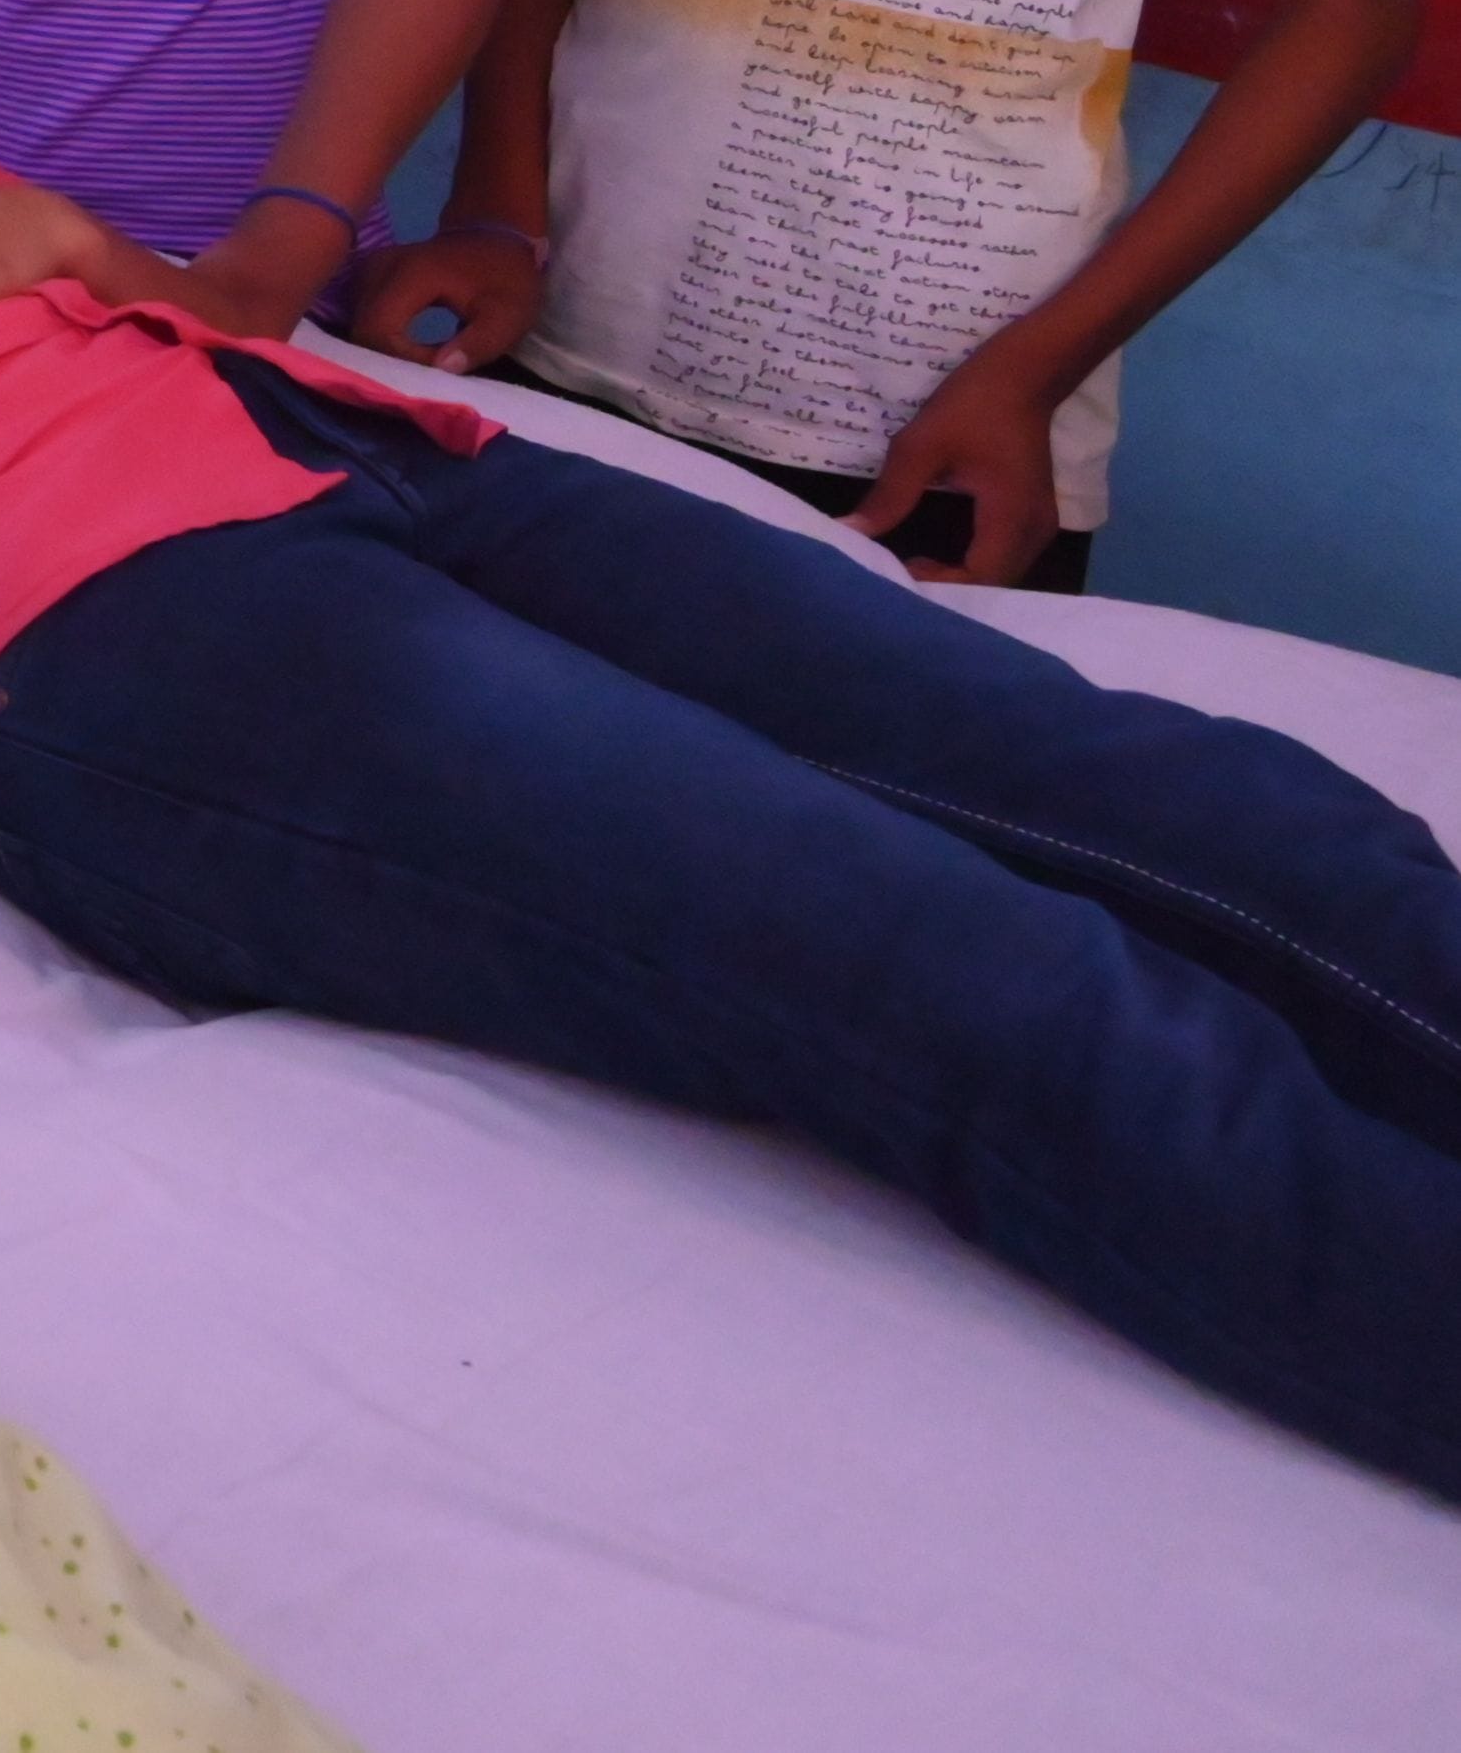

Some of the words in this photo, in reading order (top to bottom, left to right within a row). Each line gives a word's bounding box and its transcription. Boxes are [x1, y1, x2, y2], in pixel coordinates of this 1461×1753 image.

[762, 16, 809, 39] hope
[926, 52, 947, 65] to
[892, 22, 935, 38] and
[934, 4, 973, 22] and
[985, 15, 1051, 37] happy
[743, 62, 834, 94] yourself
[848, 85, 899, 100] with
[910, 92, 978, 124] happy
[755, 39, 795, 53] and
[809, 44, 853, 69] keep
[866, 57, 964, 97] learning
[738, 101, 844, 137] successful
[856, 132, 928, 154] people
[942, 149, 1045, 169] maintain
[741, 82, 781, 98] and
[792, 96, 878, 120] genuine
[891, 119, 959, 137] people
[726, 143, 796, 167] matter
[809, 167, 862, 186] what
[905, 190, 966, 211] going
[753, 128, 832, 155] positive
[844, 147, 900, 170] focus
[951, 167, 983, 192] life
[718, 160, 772, 181] them
[789, 178, 836, 208] they
[849, 200, 894, 223] stay
[906, 207, 983, 228] focused
[812, 210, 861, 229] past
[698, 220, 736, 237] and
[790, 244, 820, 261] the
[899, 274, 971, 293] action
[706, 197, 757, 221] than
[829, 237, 880, 257] past
[891, 248, 982, 273] failures
[692, 235, 728, 263] they
[745, 255, 790, 273] need
[803, 267, 822, 282] to
[835, 277, 881, 298] take
[894, 291, 915, 306] to
[672, 290, 699, 308] the
[710, 307, 761, 327] other
[776, 321, 913, 367] distractions
[752, 275, 771, 290] to
[785, 283, 818, 301] the
[829, 295, 979, 337] fulfillment
[806, 311, 876, 338] rather
[889, 334, 949, 353] than
[740, 374, 782, 394] face
[759, 359, 801, 381] feel
[762, 340, 781, 354] to
[795, 349, 854, 370] them
[694, 384, 770, 410] positive
[784, 410, 822, 424] all
